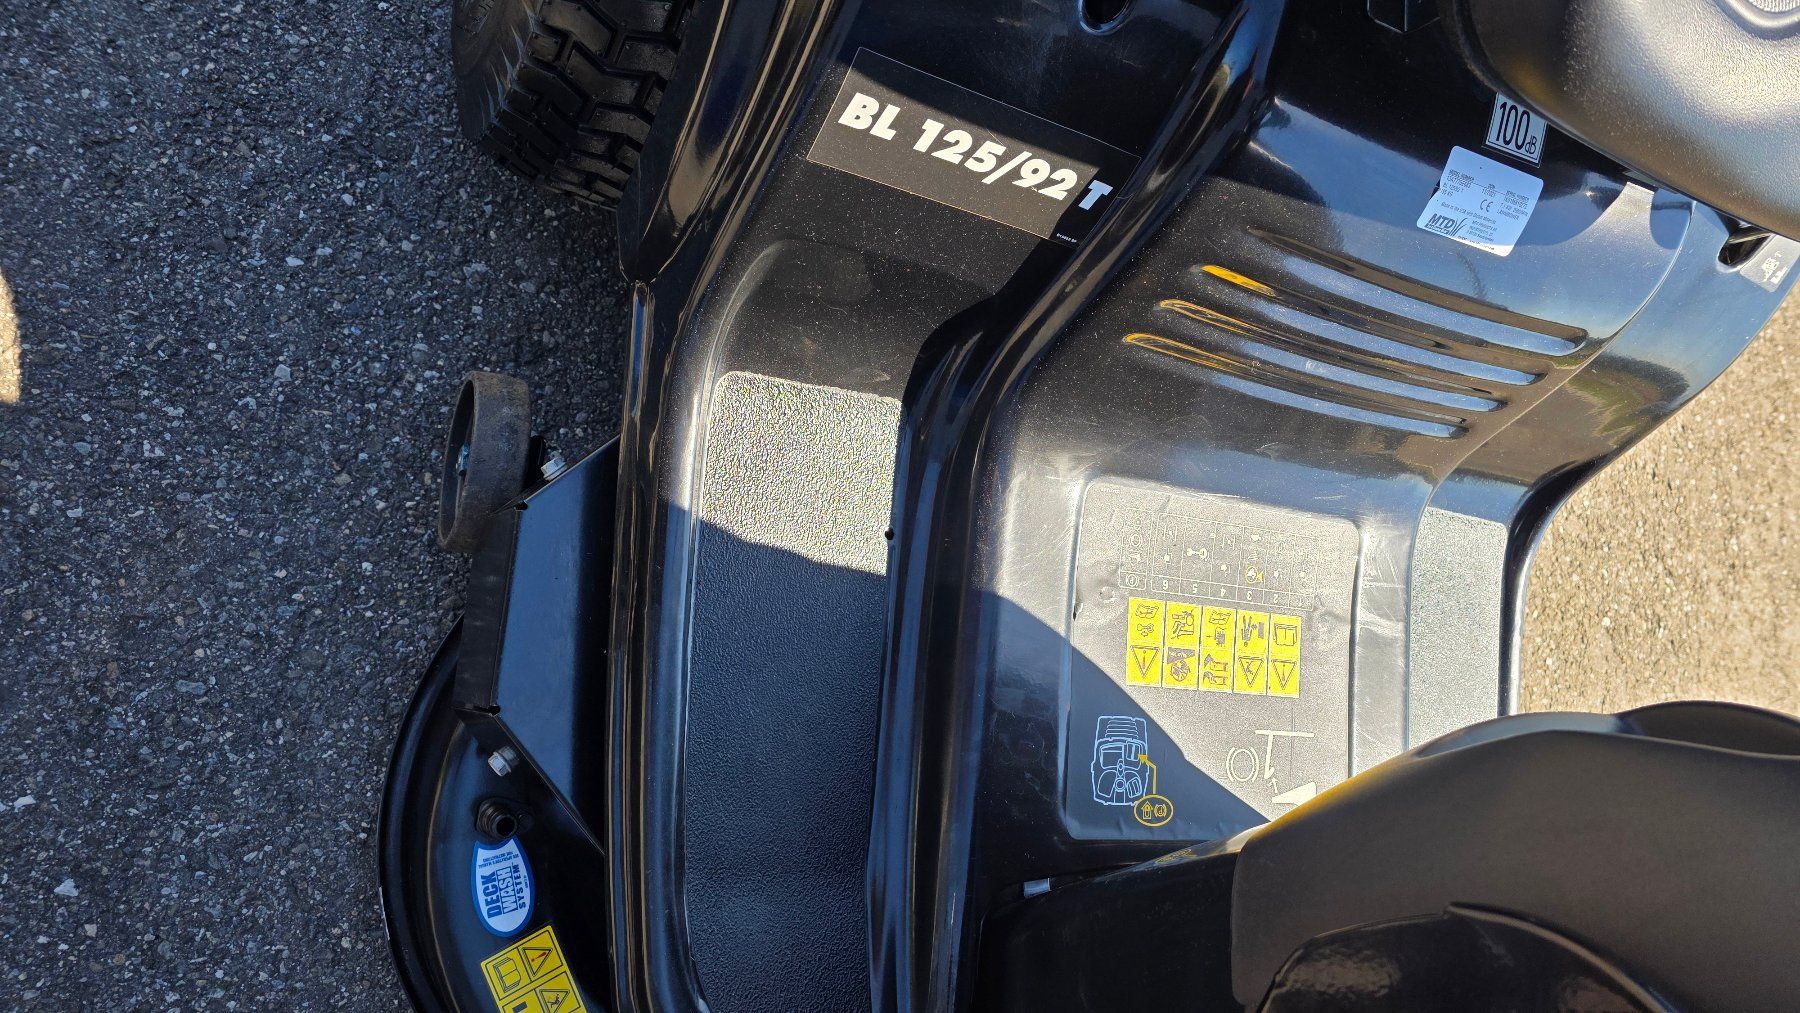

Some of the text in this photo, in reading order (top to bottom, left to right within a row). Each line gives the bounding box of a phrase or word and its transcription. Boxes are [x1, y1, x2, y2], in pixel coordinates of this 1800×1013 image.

[838, 92, 1113, 210] BL 125/92 T
[1496, 102, 1537, 154] 100 dB
[1428, 213, 1456, 230] MTD
[1192, 584, 1199, 593] 5
[481, 871, 502, 918] DECK
[496, 866, 518, 914] WASH
[512, 864, 526, 909] SYSTEM
